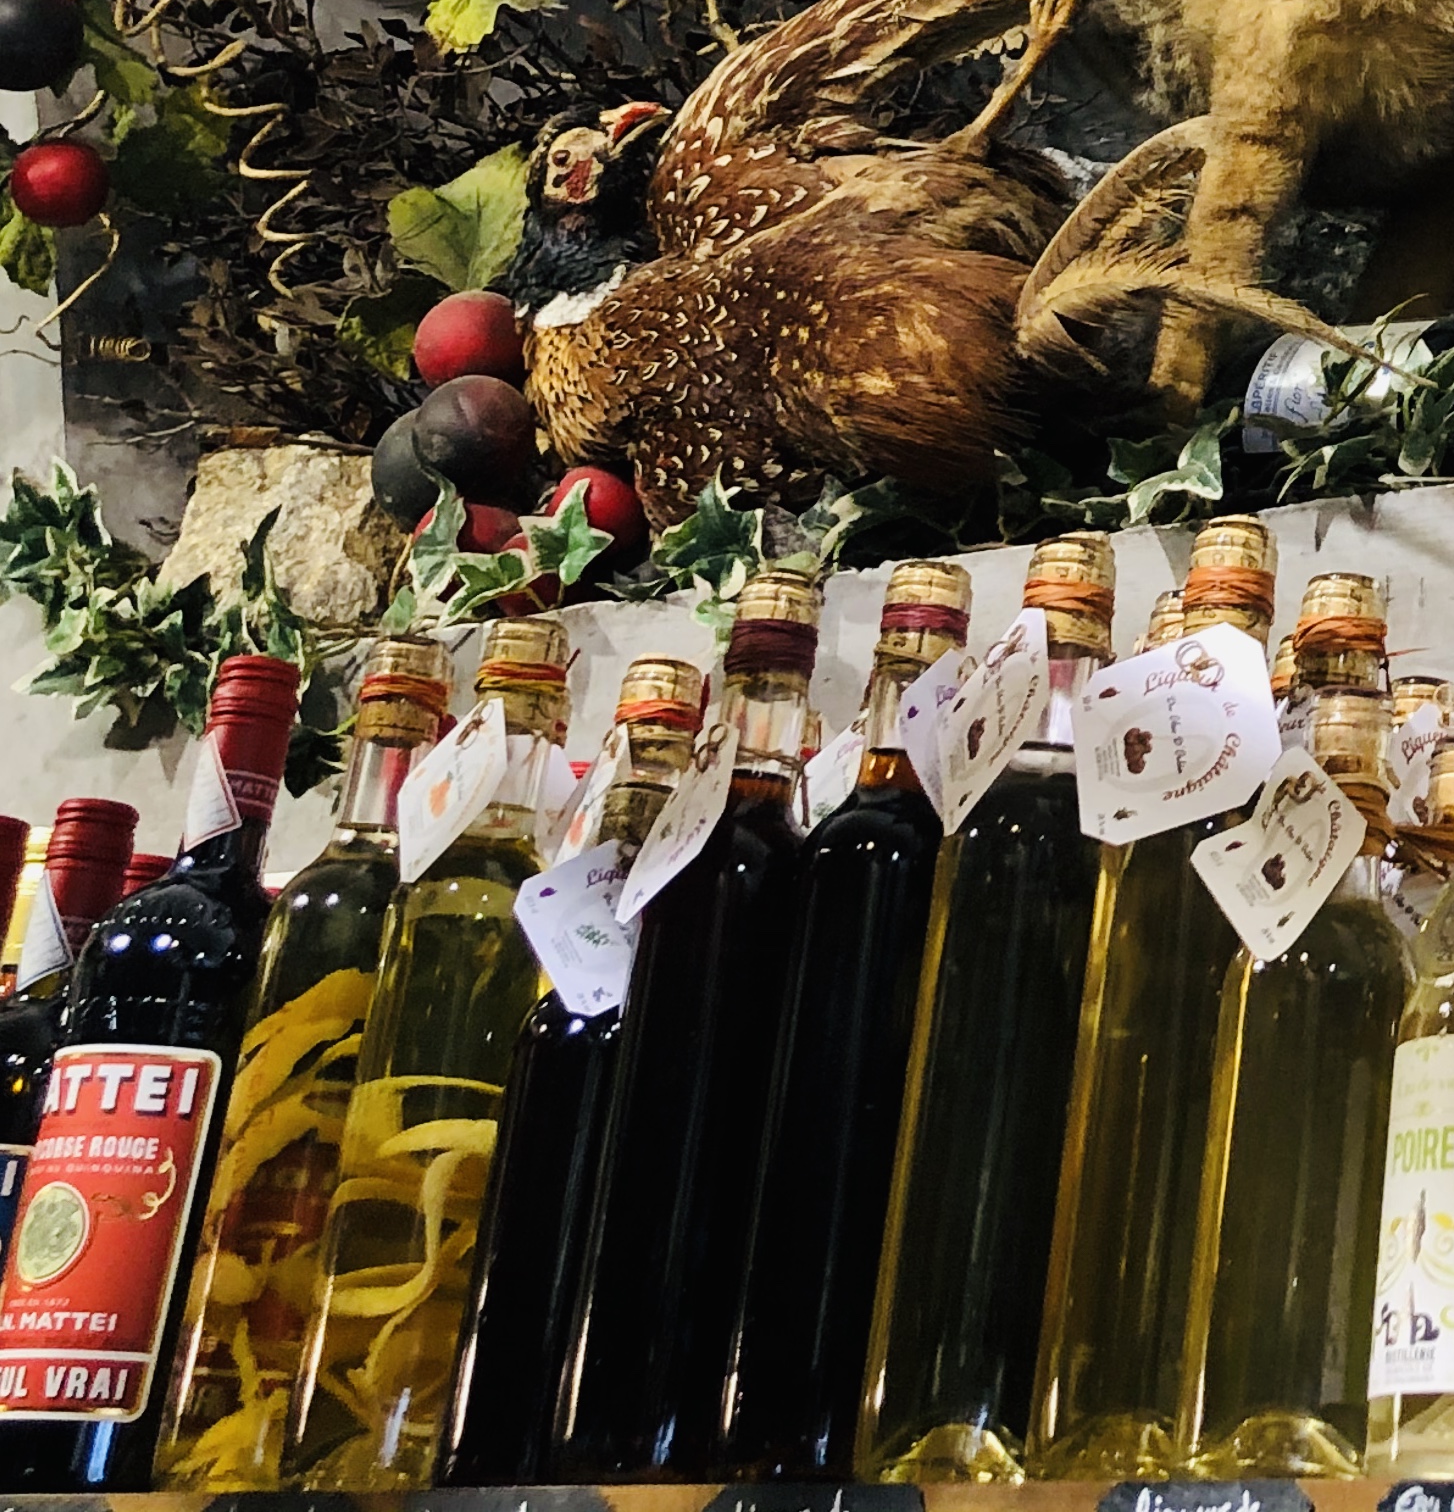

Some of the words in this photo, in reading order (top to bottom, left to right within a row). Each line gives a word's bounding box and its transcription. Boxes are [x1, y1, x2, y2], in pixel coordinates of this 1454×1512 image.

[89, 1135, 160, 1160] ROUGE
[19, 1311, 118, 1332] MATTEI
[44, 1365, 129, 1401] VRAI
